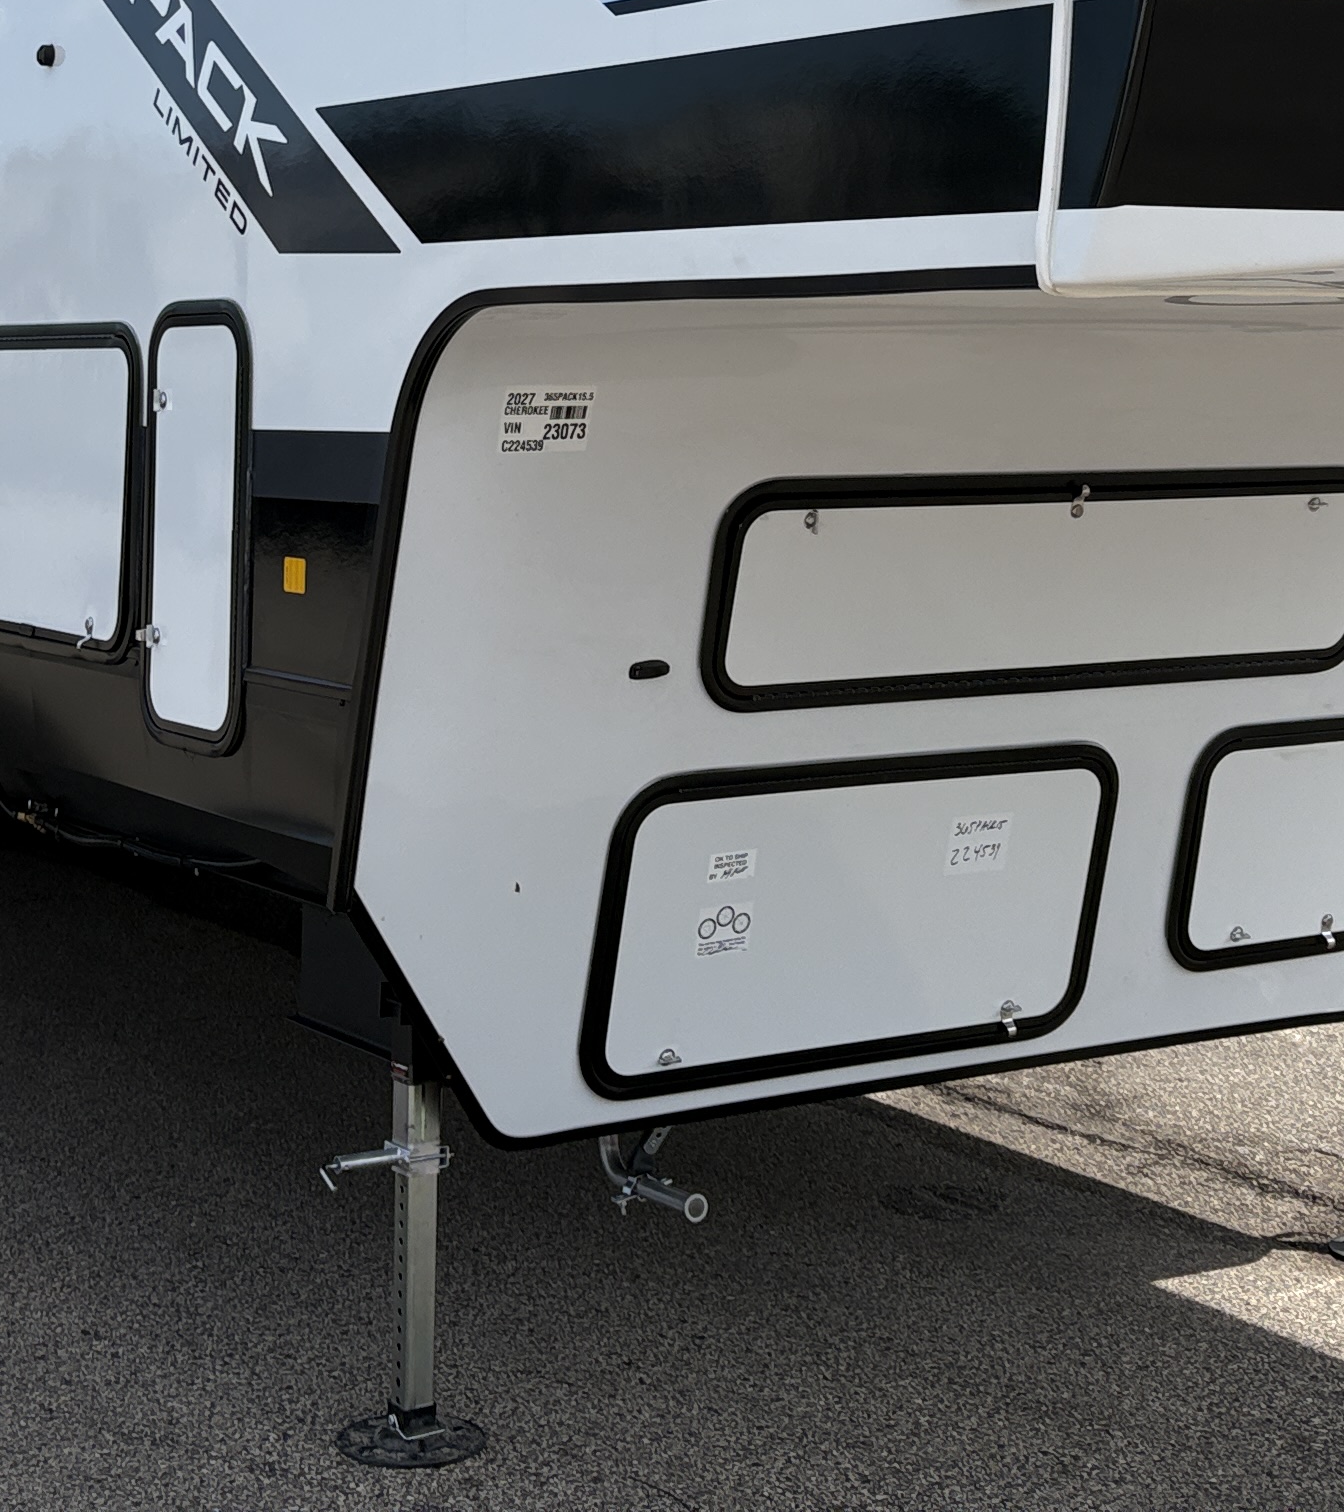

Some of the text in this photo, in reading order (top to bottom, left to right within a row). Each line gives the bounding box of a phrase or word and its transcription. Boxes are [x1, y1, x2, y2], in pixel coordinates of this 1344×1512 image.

[153, 87, 248, 237] LIMITED
[506, 392, 536, 405] 2027
[504, 405, 549, 415] CHEROKEE
[503, 421, 587, 440] VIN 23073
[501, 439, 544, 452] C224539
